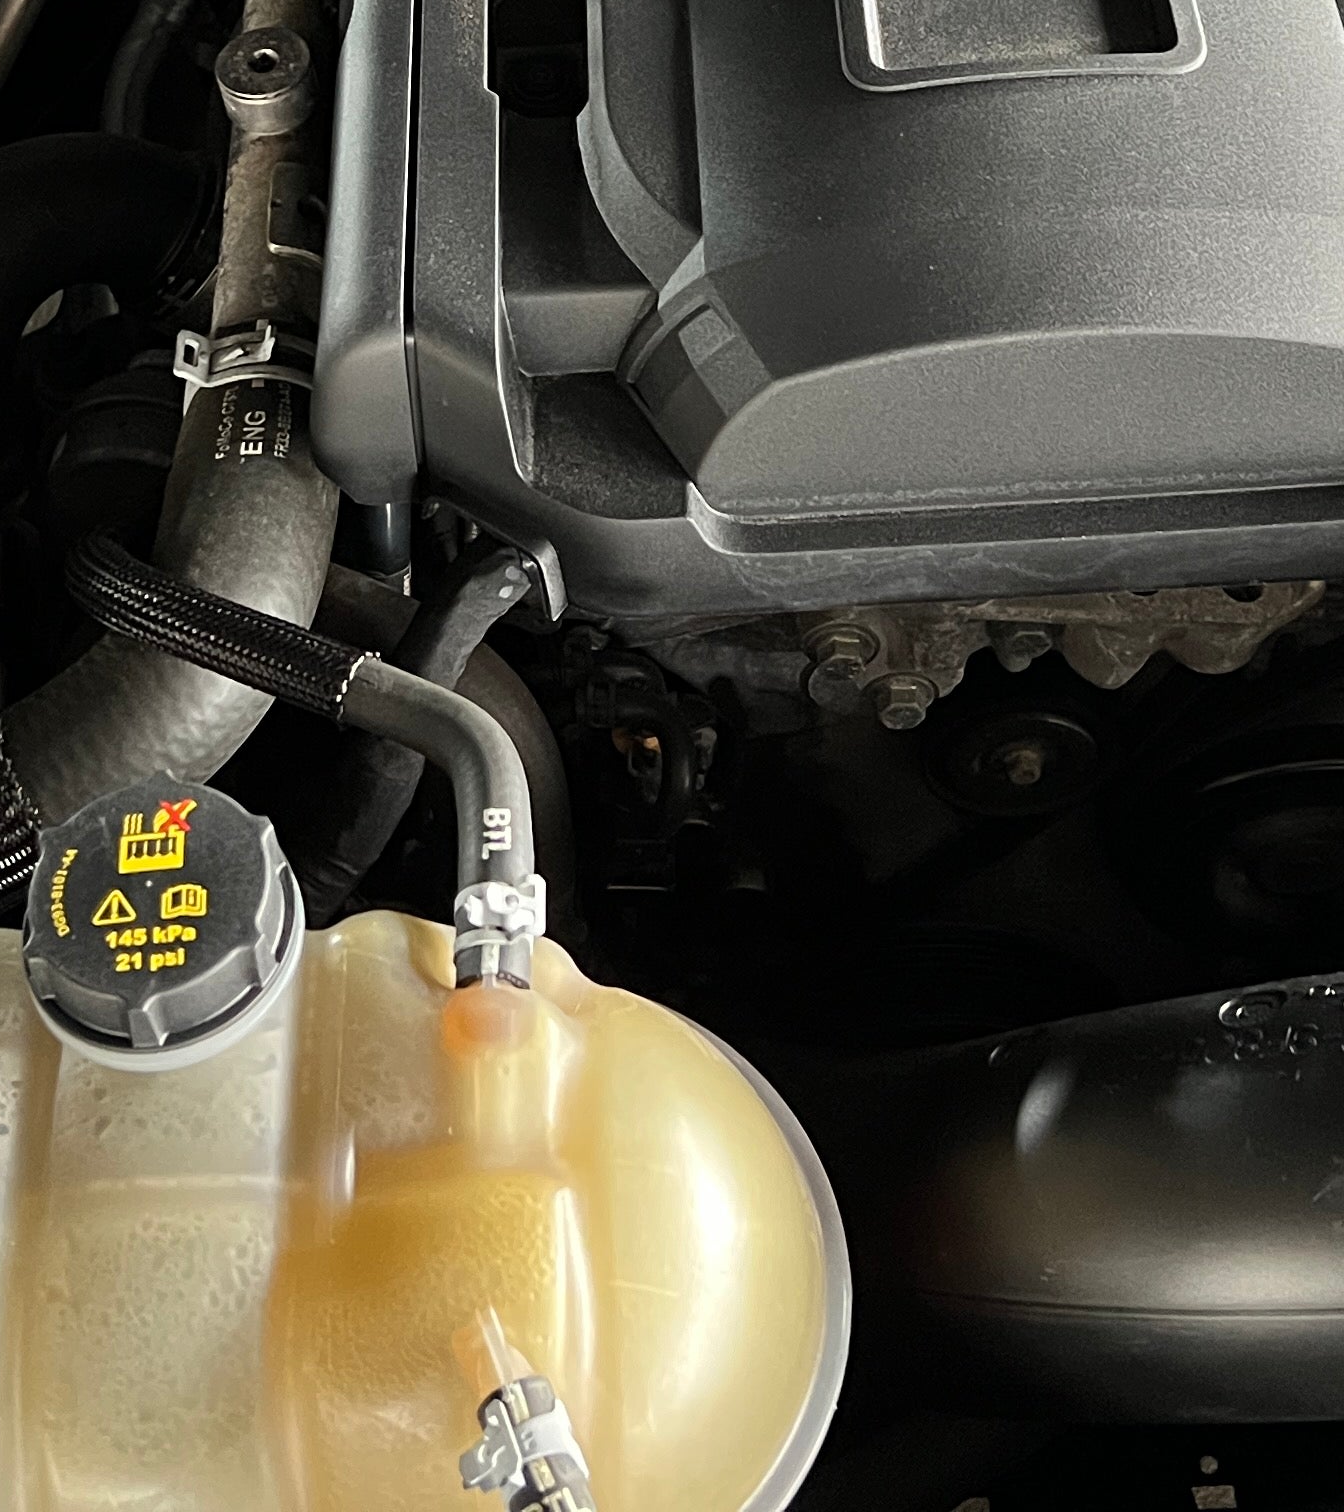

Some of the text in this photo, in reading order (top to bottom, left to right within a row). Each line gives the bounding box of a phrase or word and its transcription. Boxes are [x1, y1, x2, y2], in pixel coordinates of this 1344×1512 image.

[239, 409, 267, 456] ENG
[481, 807, 512, 861] BTL
[105, 925, 197, 949] 145 kPa
[114, 948, 186, 973] 21 psi
